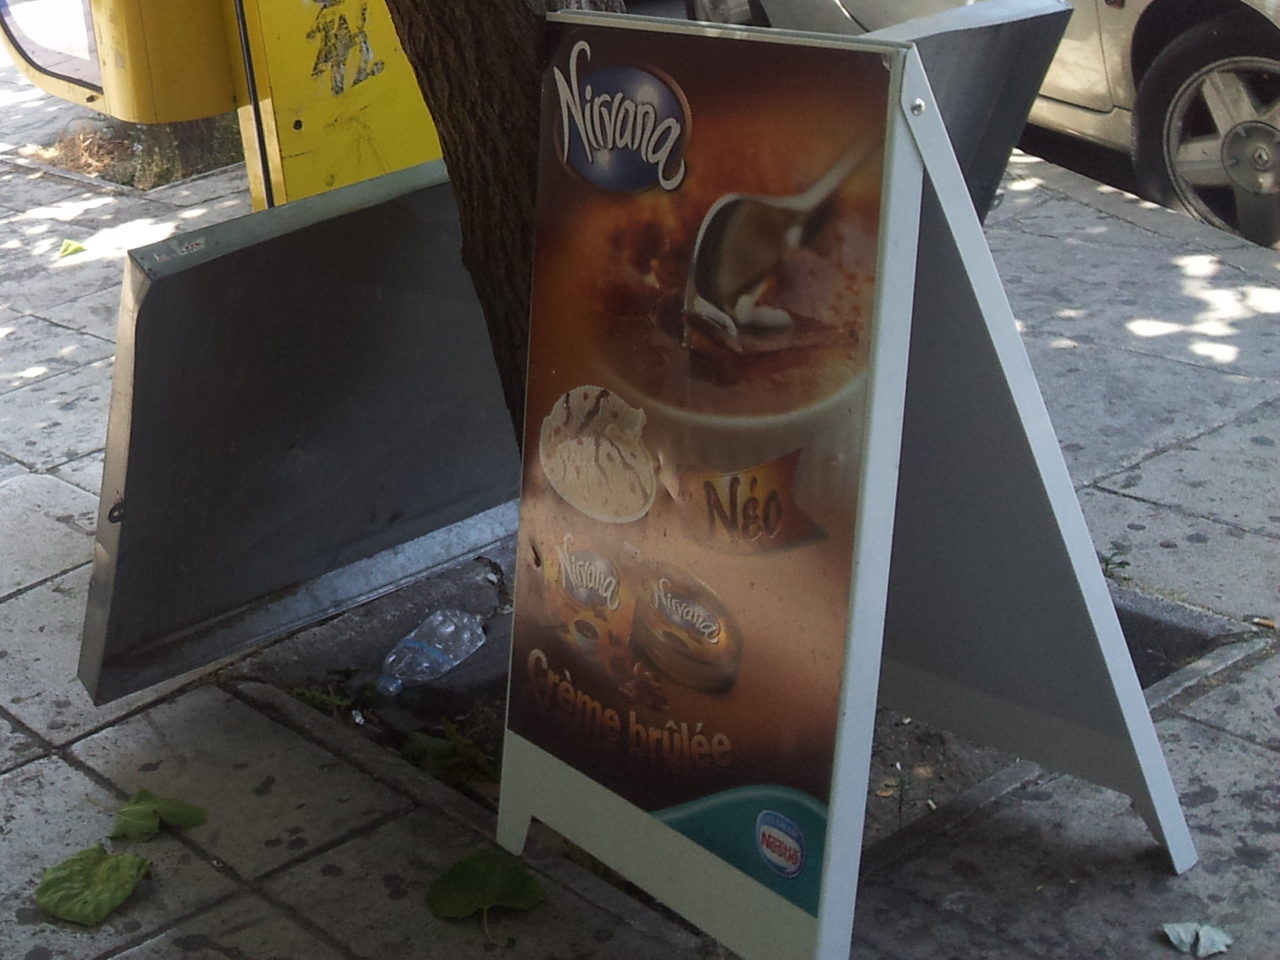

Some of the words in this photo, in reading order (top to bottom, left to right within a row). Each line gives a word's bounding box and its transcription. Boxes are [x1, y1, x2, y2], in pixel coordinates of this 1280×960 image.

[553, 40, 686, 191] Nirvana
[556, 533, 620, 611] Nirvana
[650, 578, 721, 644] Nirvana
[527, 648, 621, 732] Crème
[629, 710, 732, 767] brûlée
